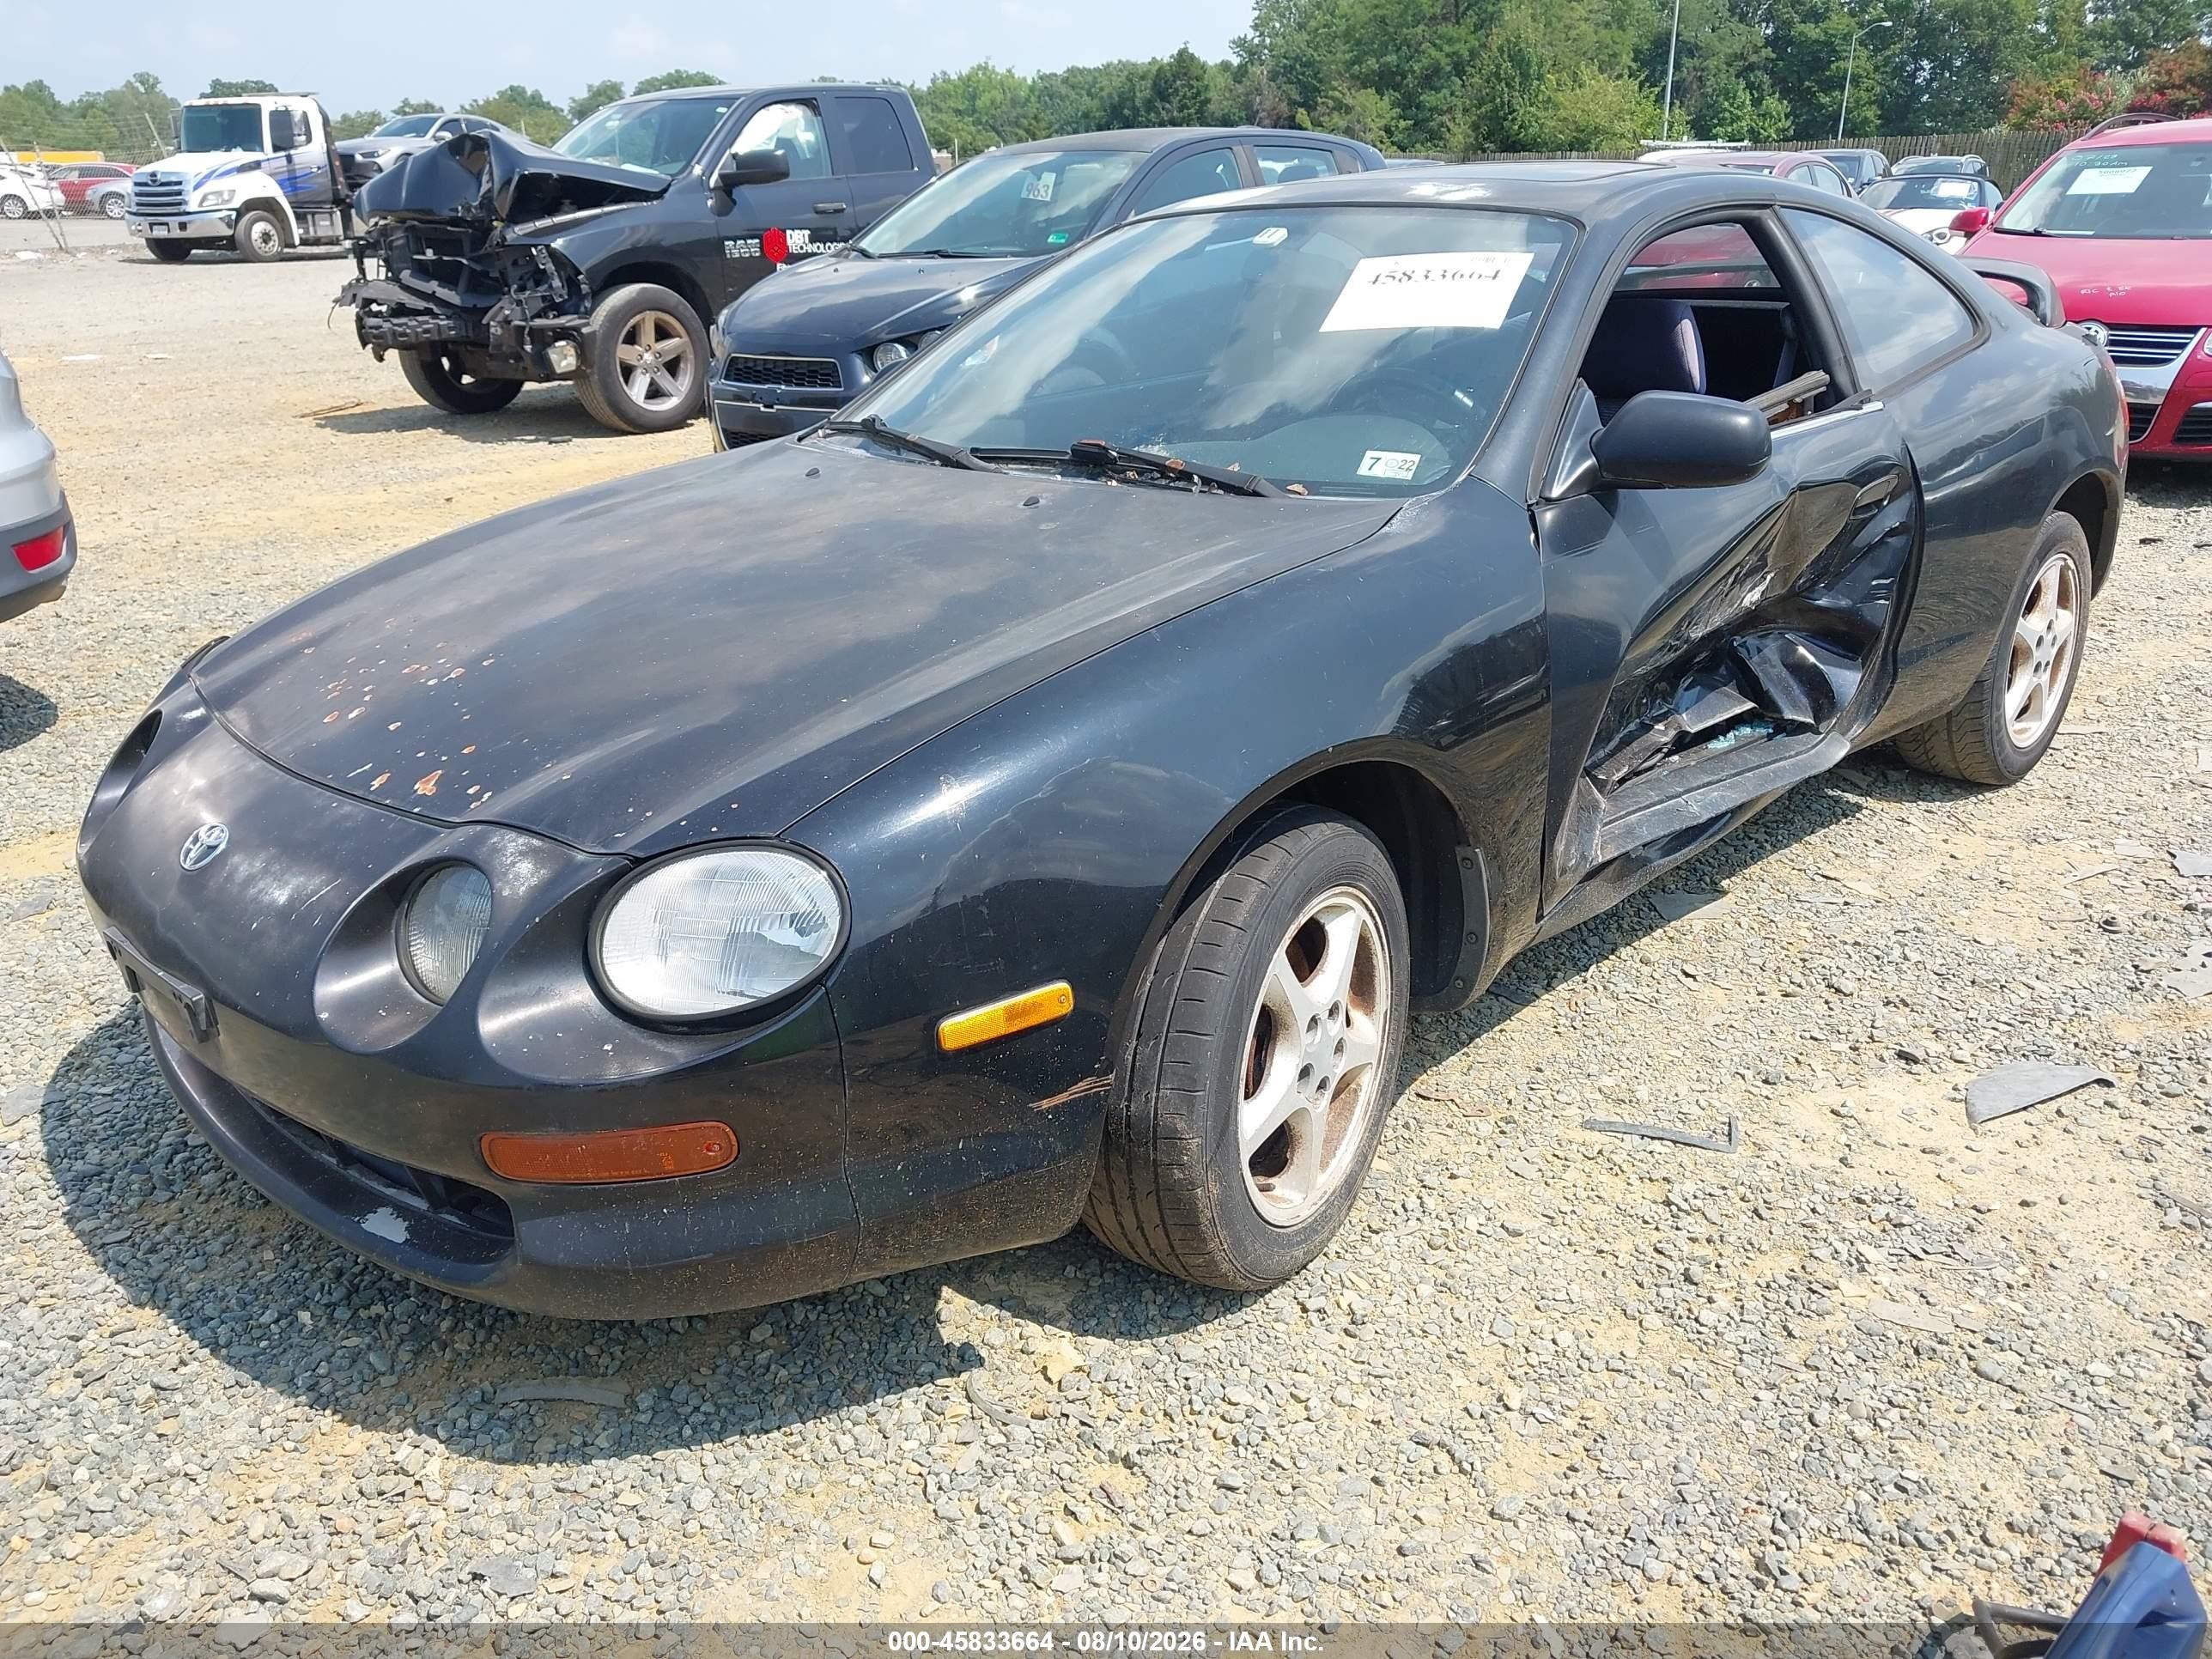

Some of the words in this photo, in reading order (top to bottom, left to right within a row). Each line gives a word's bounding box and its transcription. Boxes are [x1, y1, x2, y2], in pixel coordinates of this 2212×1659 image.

[1025, 183, 1050, 198] 963
[786, 229, 811, 244] DBT
[724, 239, 761, 249] RAM
[787, 241, 852, 254] TECHNOLOG
[725, 247, 762, 258] 1500
[1368, 456, 1382, 471] 7
[1398, 459, 1416, 471] 22
